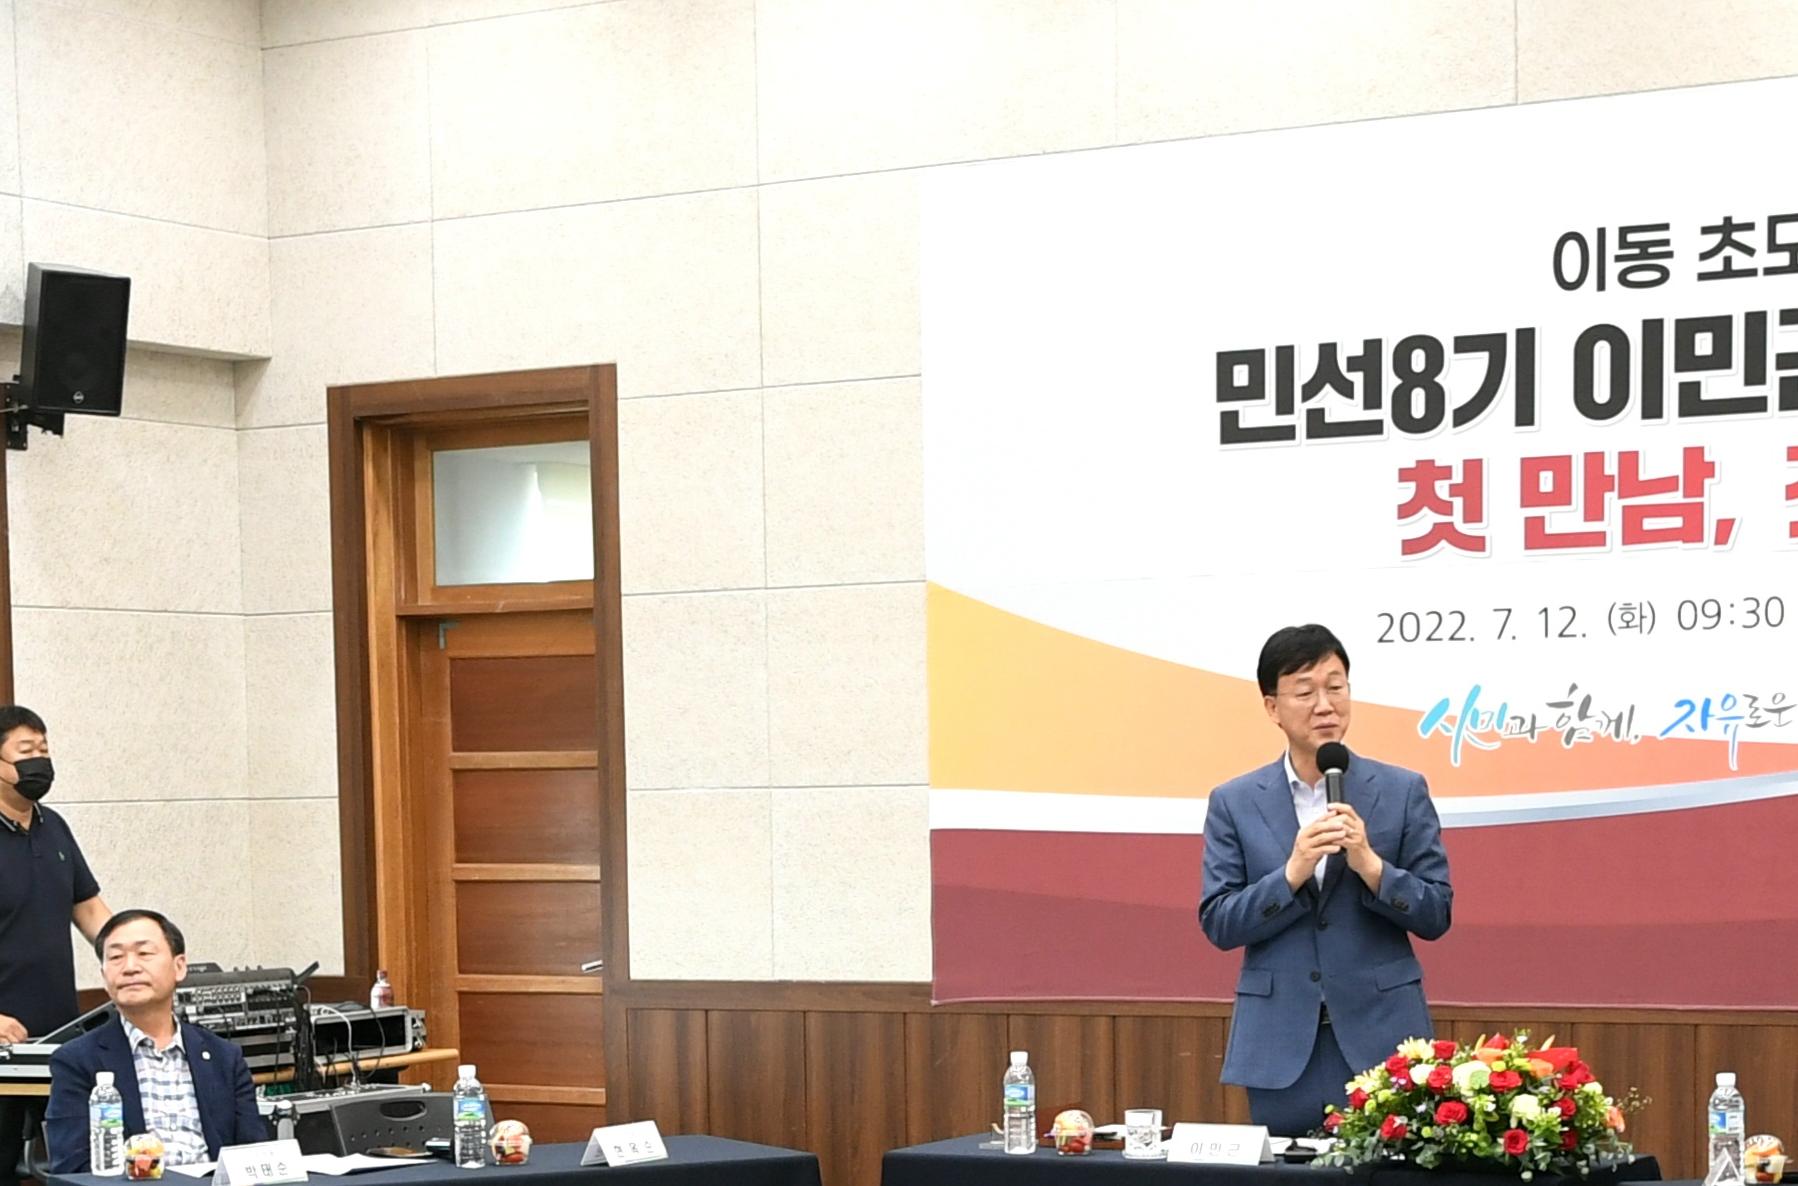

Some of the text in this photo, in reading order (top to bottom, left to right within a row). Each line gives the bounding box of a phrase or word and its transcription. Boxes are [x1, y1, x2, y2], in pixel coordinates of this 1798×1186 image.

[1552, 222, 1675, 292] 이동
[1215, 326, 1536, 445] 민선8기
[1396, 457, 1486, 557] 첫
[1519, 445, 1737, 551] 만남,
[1376, 610, 1475, 644] 2022.
[1492, 607, 1517, 641] 7.
[1537, 604, 1588, 639] 12.
[1607, 599, 1657, 637] (화)
[1676, 595, 1786, 631] 09:30
[1660, 691, 1798, 769] 자유로운
[1190, 1142, 1241, 1157] 이민근
